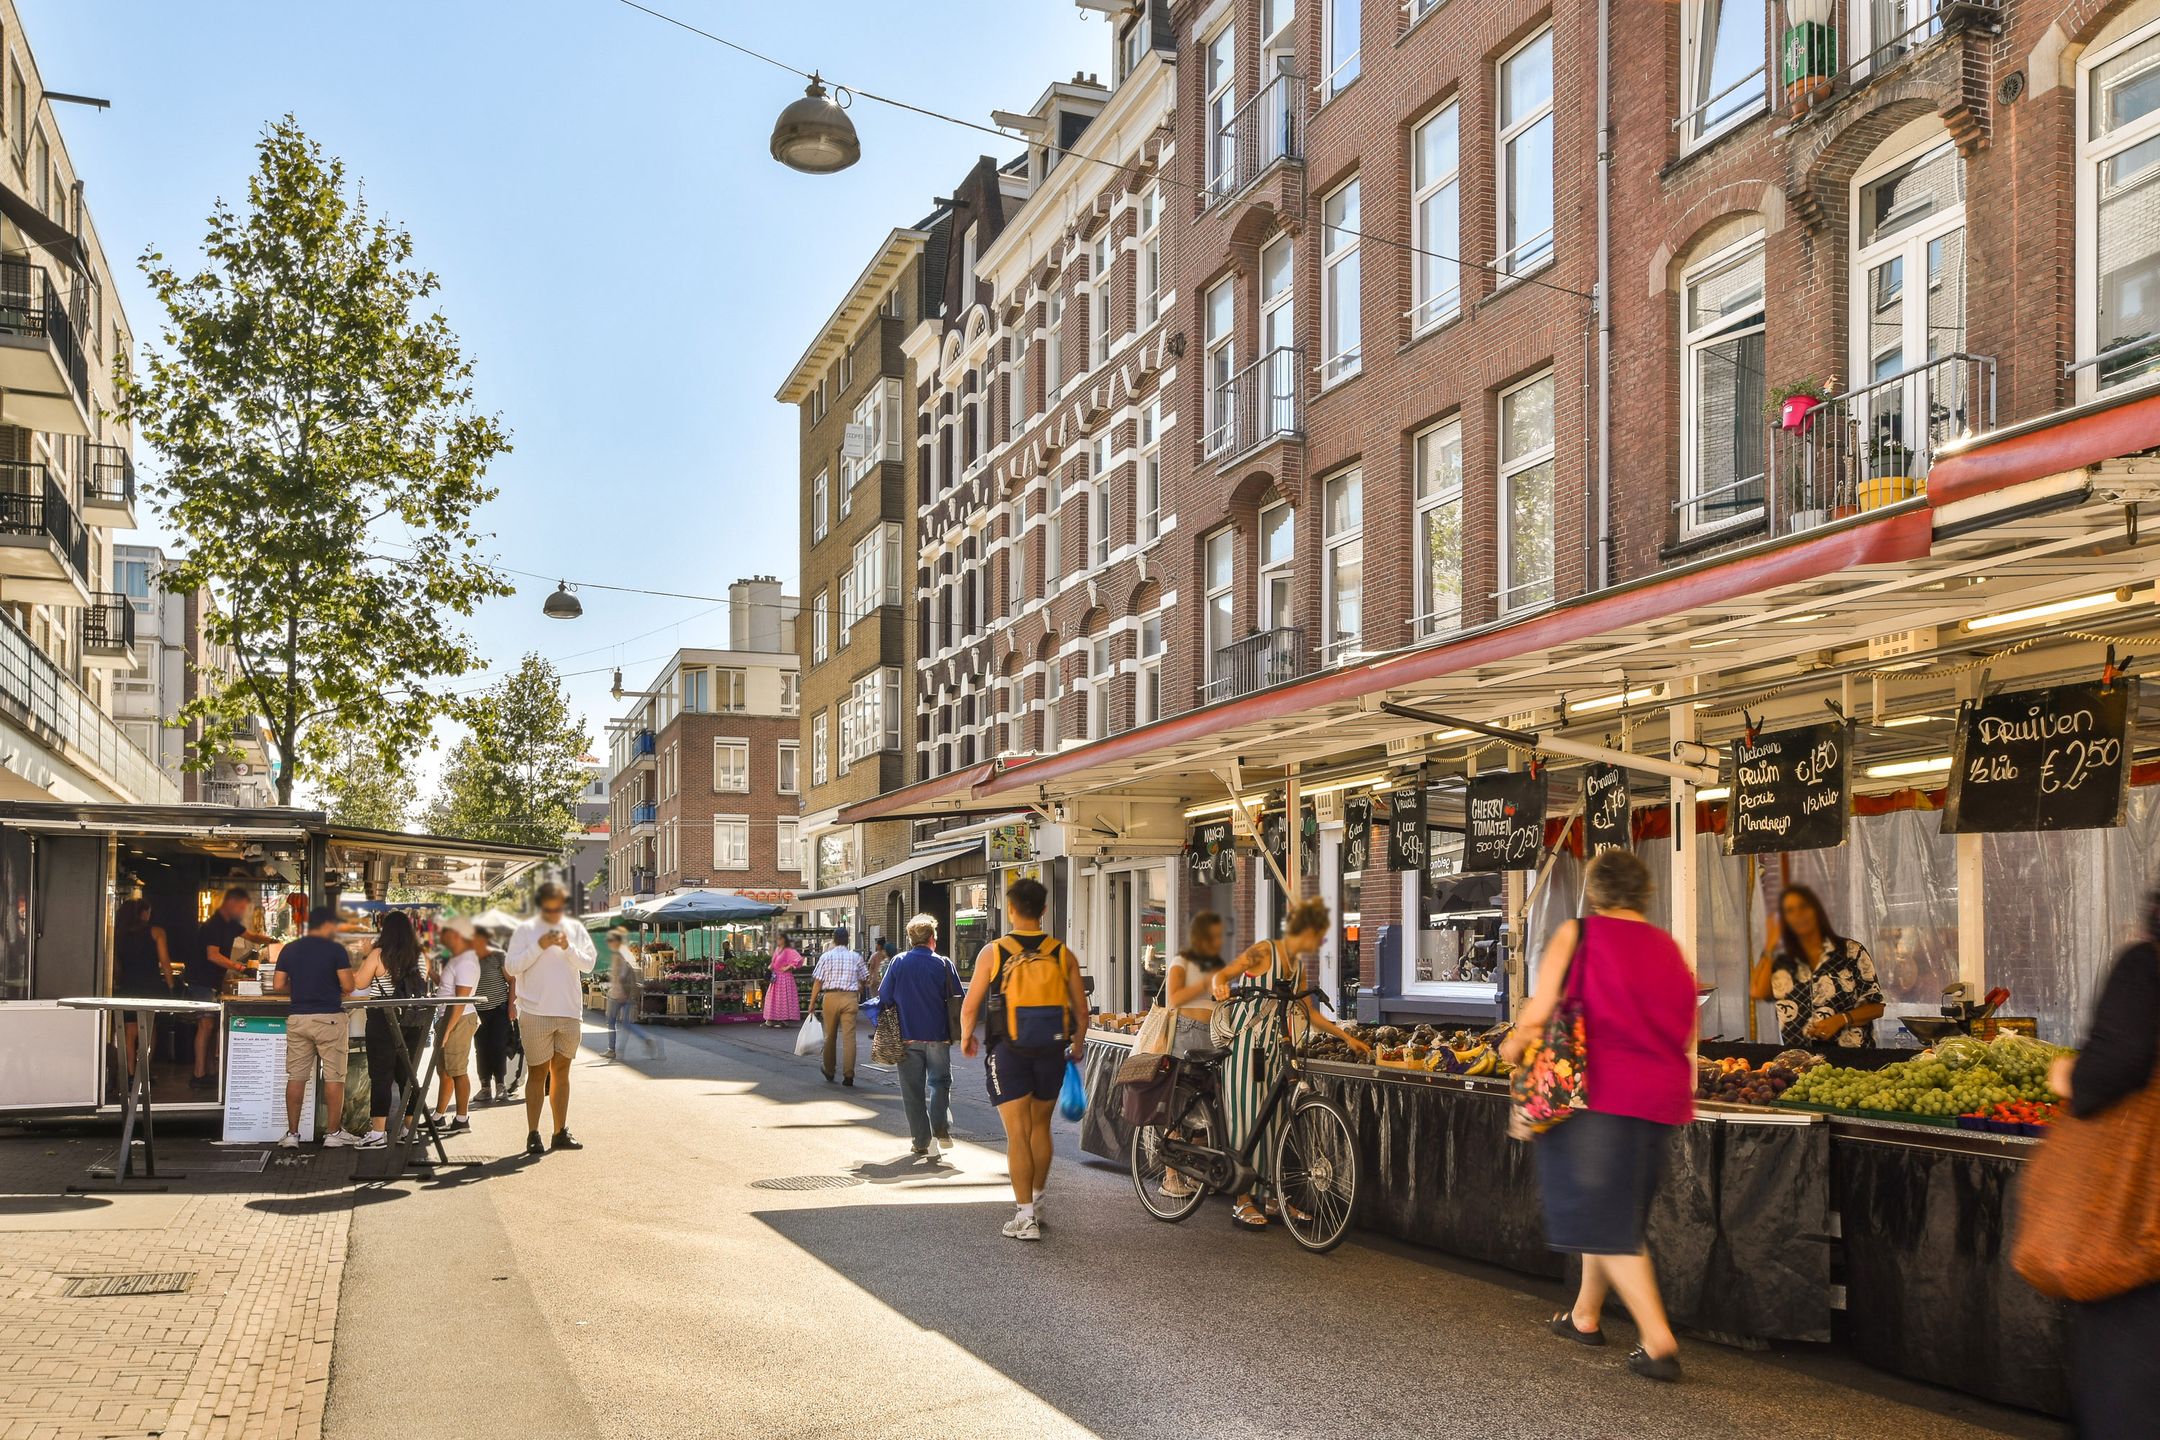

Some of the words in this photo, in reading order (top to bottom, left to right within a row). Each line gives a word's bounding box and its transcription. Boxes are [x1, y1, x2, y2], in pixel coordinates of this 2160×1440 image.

[1471, 798, 1504, 819] CHERRY
[1739, 791, 1775, 813] Perzik
[1203, 826, 1225, 844] MANGO
[1348, 823, 1354, 840] 6
[1396, 822, 1403, 847] 4
[1473, 817, 1512, 837] TOMATEN
[1476, 840, 1493, 855] 500
[1191, 851, 1200, 870] 2
